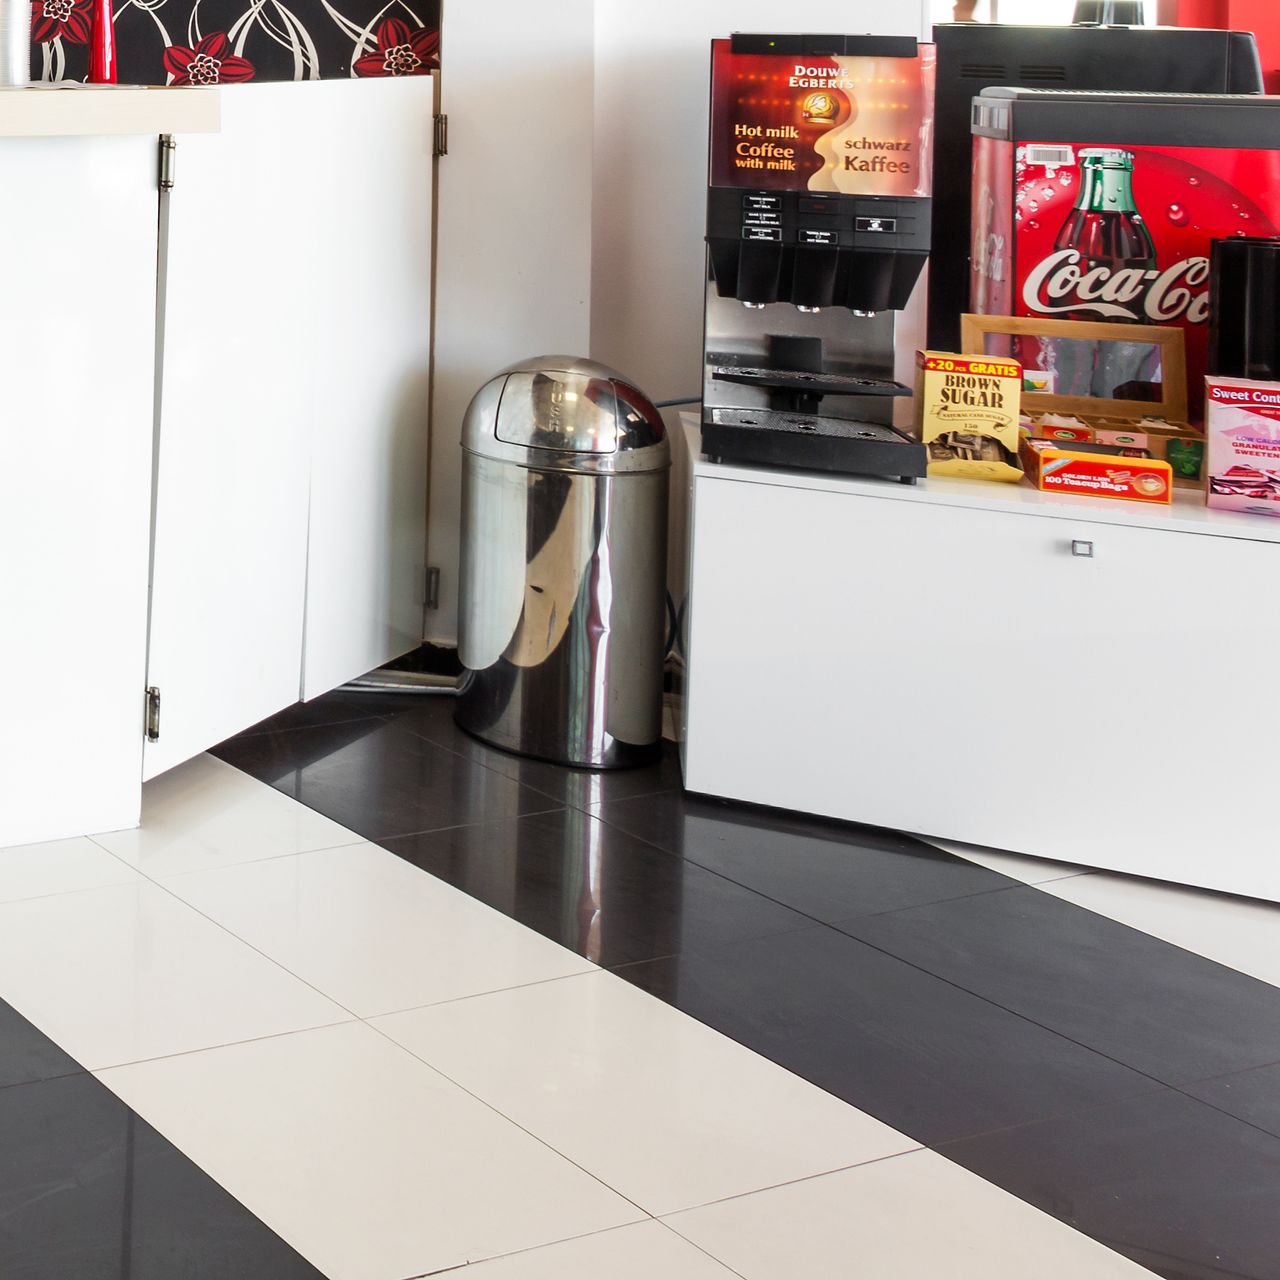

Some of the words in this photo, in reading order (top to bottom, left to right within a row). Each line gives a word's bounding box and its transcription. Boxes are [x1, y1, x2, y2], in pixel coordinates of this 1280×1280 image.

[789, 76, 855, 89] EGBERTS
[734, 124, 761, 137] Hot
[766, 126, 799, 139] milk
[736, 142, 795, 159] Coffee
[844, 137, 912, 152] schwarz
[736, 157, 763, 169] with
[766, 159, 796, 171] milk
[844, 156, 911, 174] Kaffee
[927, 359, 954, 371] +20
[969, 362, 1018, 377] GRATIS
[945, 374, 1002, 391] BROWN
[940, 387, 1004, 408] SUGAR
[1212, 388, 1250, 401] Sweet
[1045, 475, 1062, 484] 100
